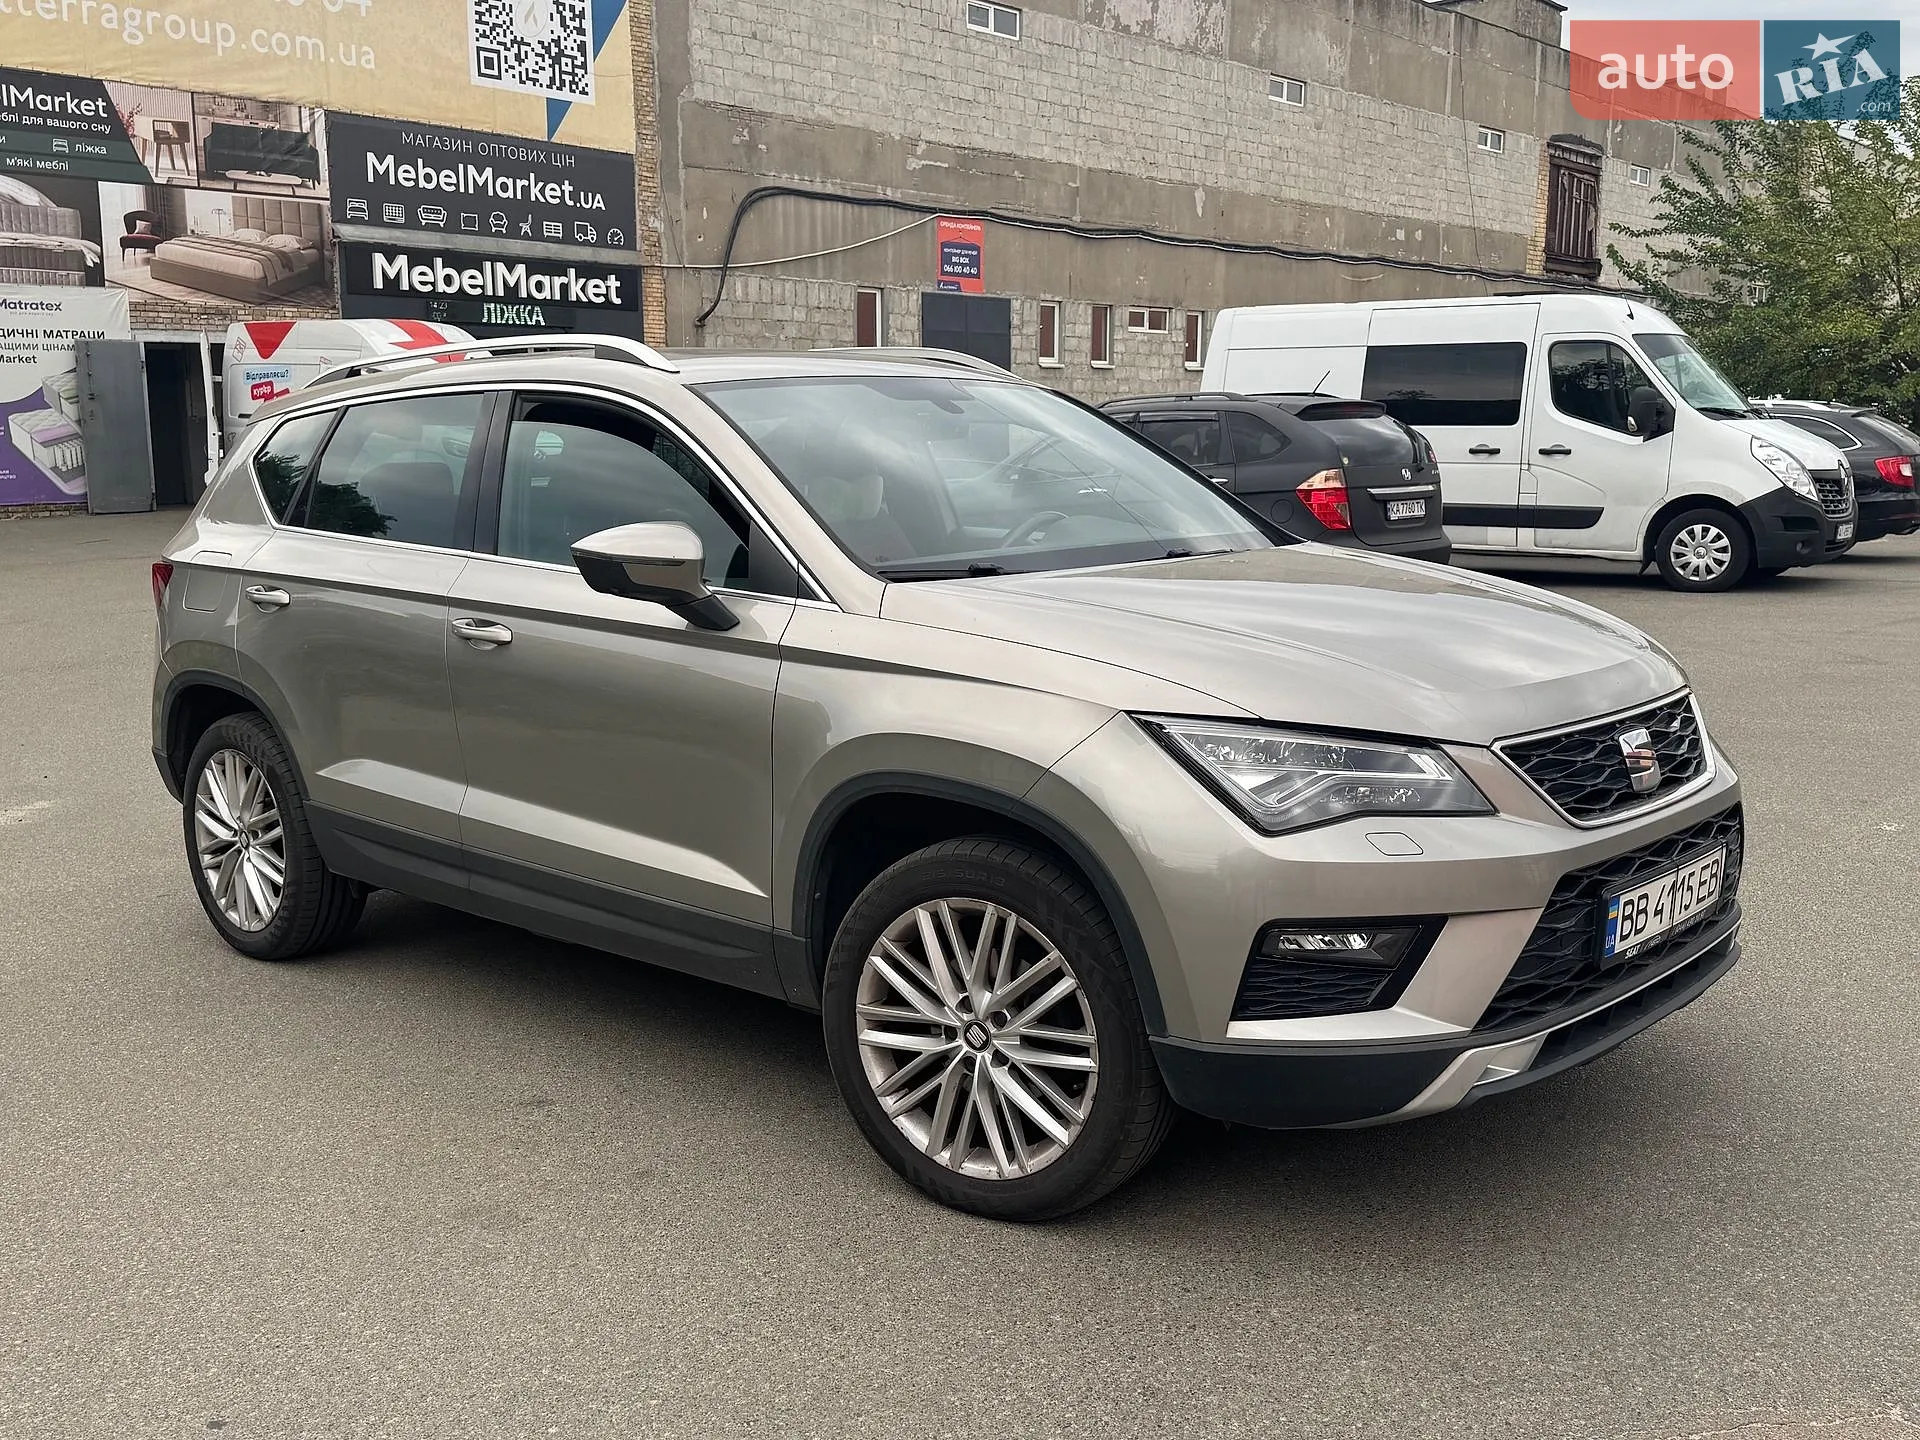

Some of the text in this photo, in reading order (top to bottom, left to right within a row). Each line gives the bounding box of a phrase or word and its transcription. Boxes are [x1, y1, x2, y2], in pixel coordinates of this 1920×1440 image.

[0, 83, 108, 118] lMarket
[0, 111, 112, 135] блі для вашого сну
[75, 142, 107, 155] ліжка
[402, 131, 576, 168] МАГАЗИН ОПТОВИХ ЦІН
[6, 156, 69, 171] м'які меблі
[366, 151, 606, 211] MebelMarket.UA
[372, 252, 622, 305] MebelMarket
[954, 265, 962, 274] 100
[963, 266, 970, 274] 40
[970, 267, 977, 275] 40
[481, 302, 546, 326] ЛІЖКА
[43, 329, 105, 339] МАТРАЦИ
[1619, 892, 1649, 943] BB
[1653, 870, 1696, 925] 4115
[1695, 858, 1720, 906] EB
[1605, 934, 1615, 950] UA
[1625, 944, 1641, 959] SEAT
